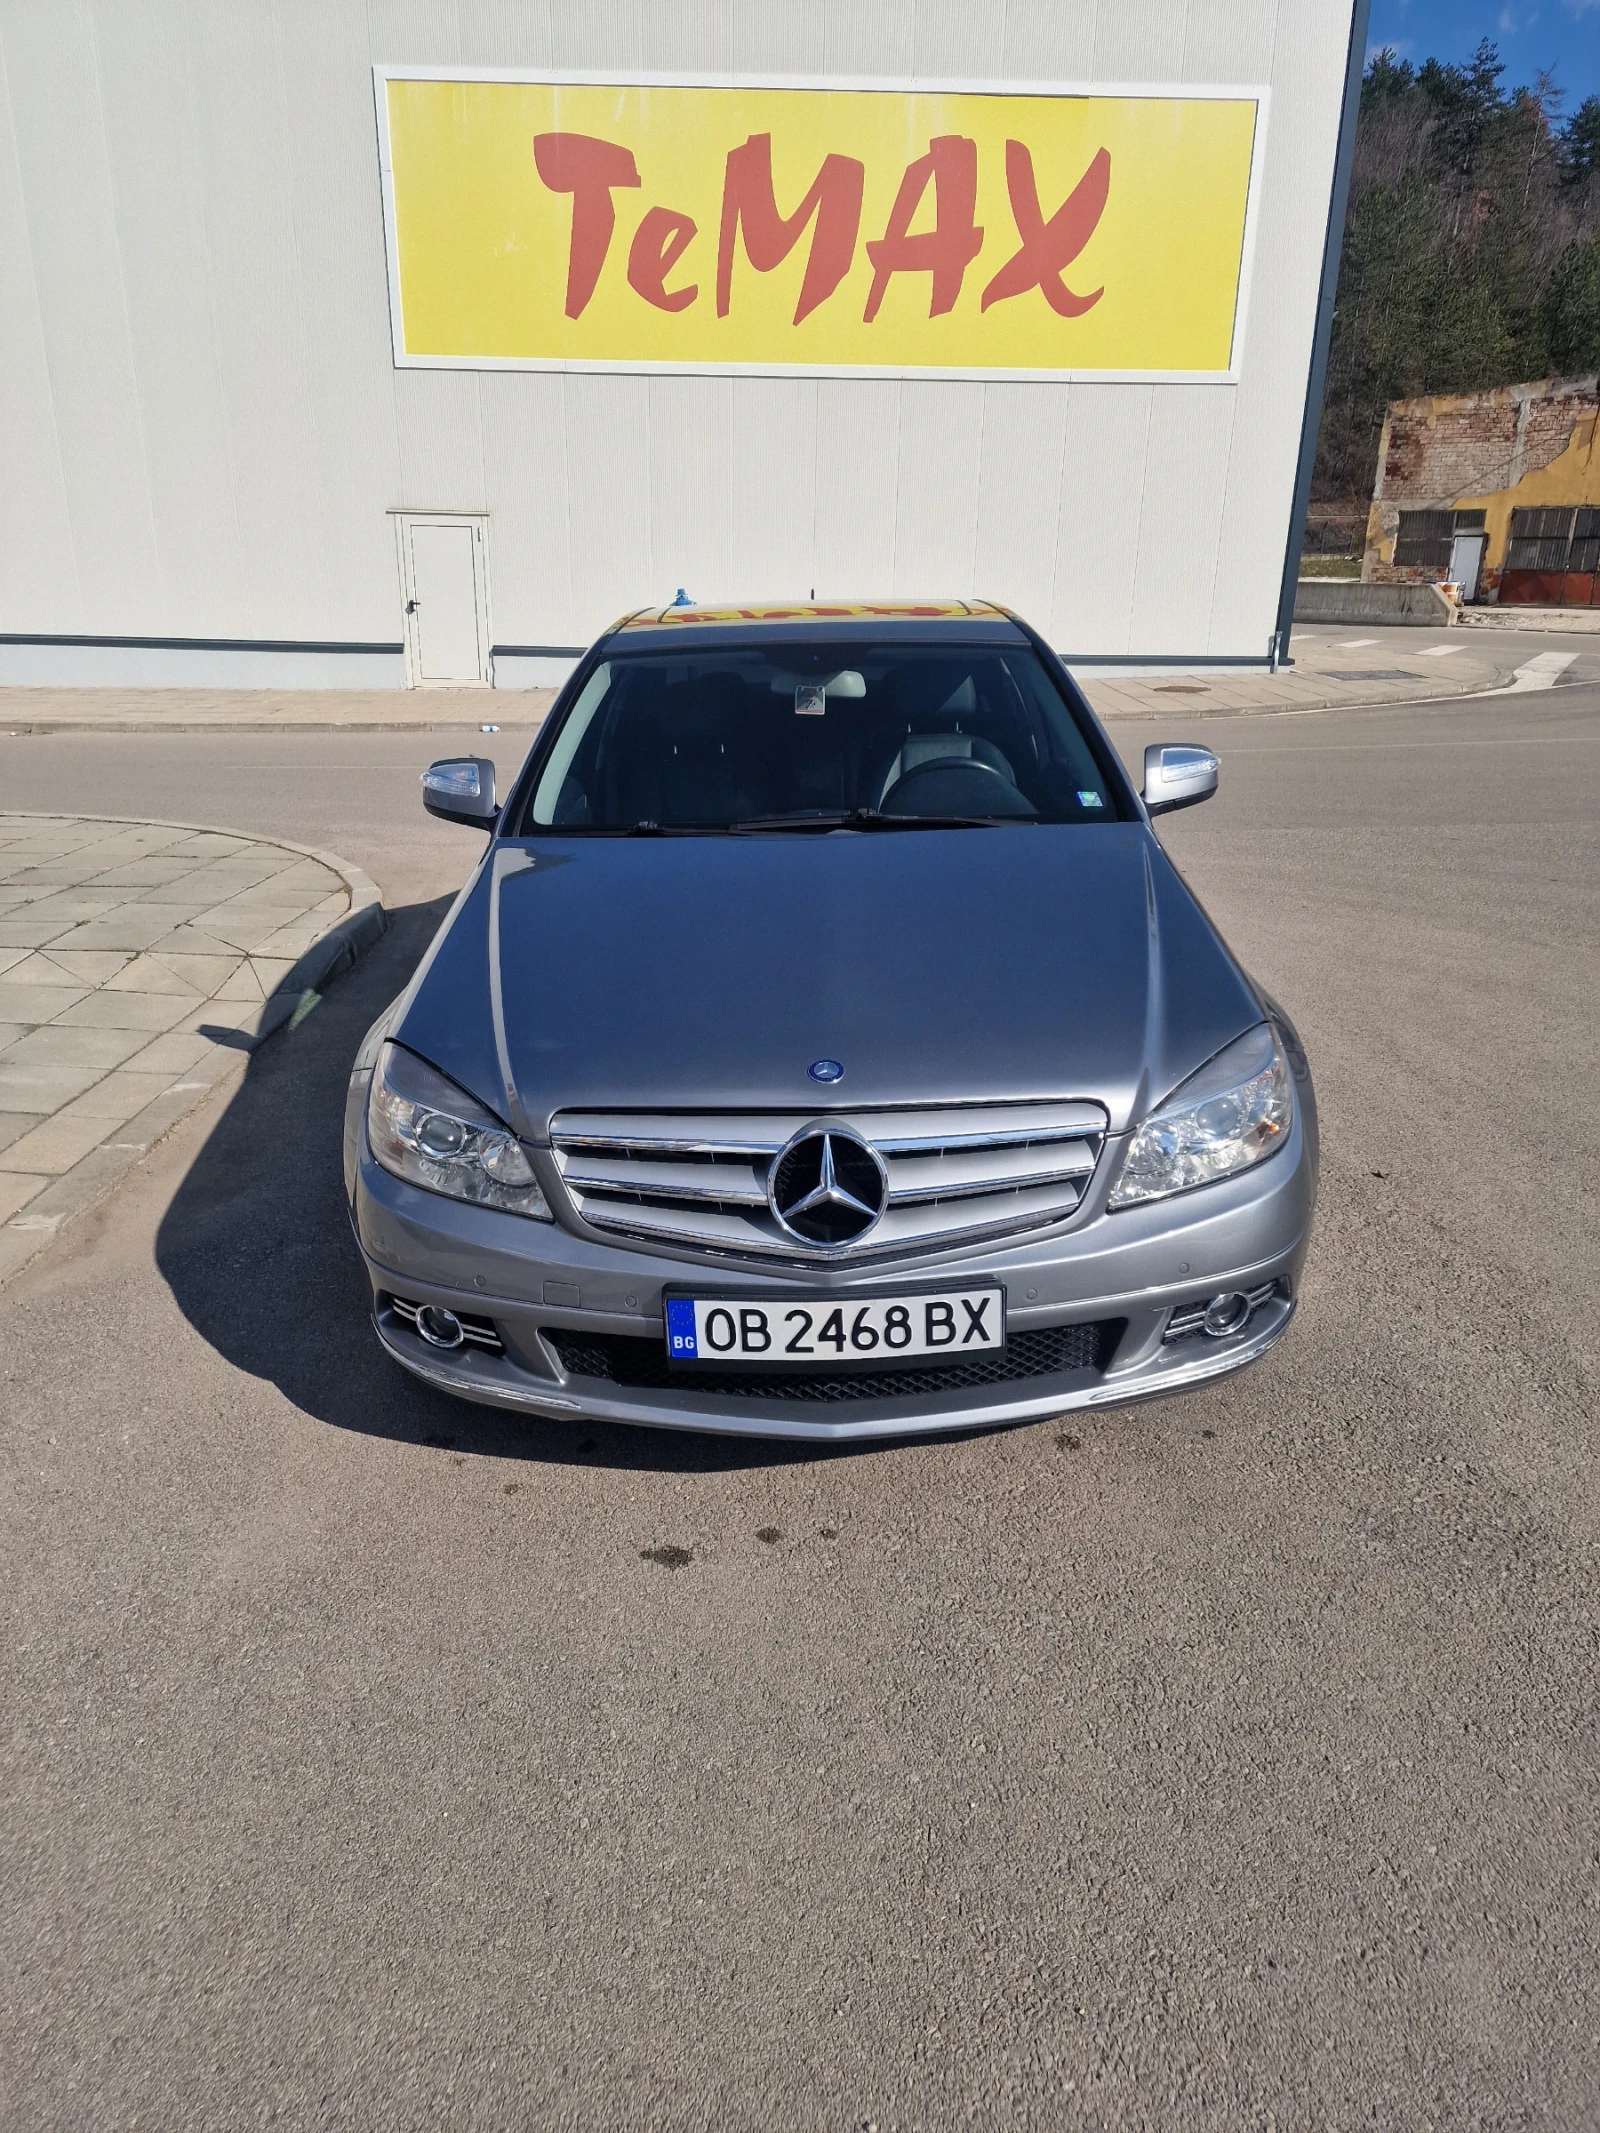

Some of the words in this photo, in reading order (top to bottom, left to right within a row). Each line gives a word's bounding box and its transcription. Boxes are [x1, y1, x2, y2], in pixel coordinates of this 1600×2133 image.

[534, 133, 1110, 325] TeMAX
[673, 1336, 695, 1349] BG
[705, 1308, 772, 1353] OB
[784, 1306, 912, 1354] 2468
[925, 1297, 991, 1347] BX
